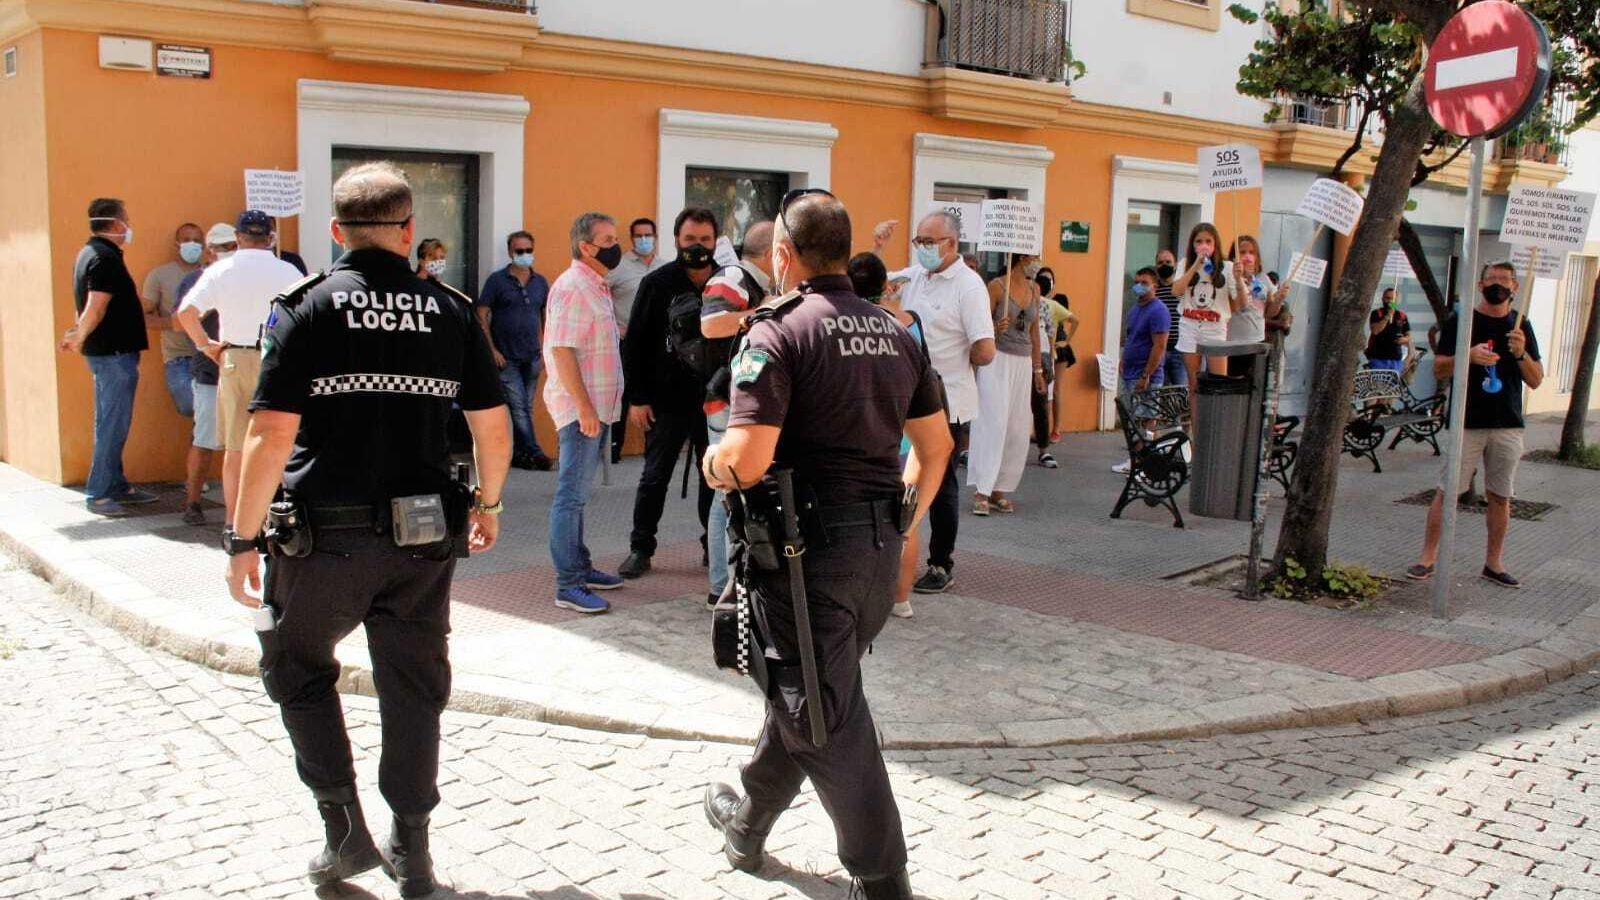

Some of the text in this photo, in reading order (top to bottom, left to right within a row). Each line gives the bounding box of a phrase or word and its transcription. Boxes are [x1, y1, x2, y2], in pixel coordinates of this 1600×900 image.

[1216, 150, 1240, 163] SOS
[1212, 168, 1243, 177] AYUDAS
[1209, 178, 1248, 189] URGENTES
[1521, 189, 1545, 198] SOMOS
[332, 290, 441, 314] POLICIA
[346, 310, 432, 332] LOCAL
[822, 315, 898, 336] POLICIA
[838, 337, 899, 357] LOCAL
